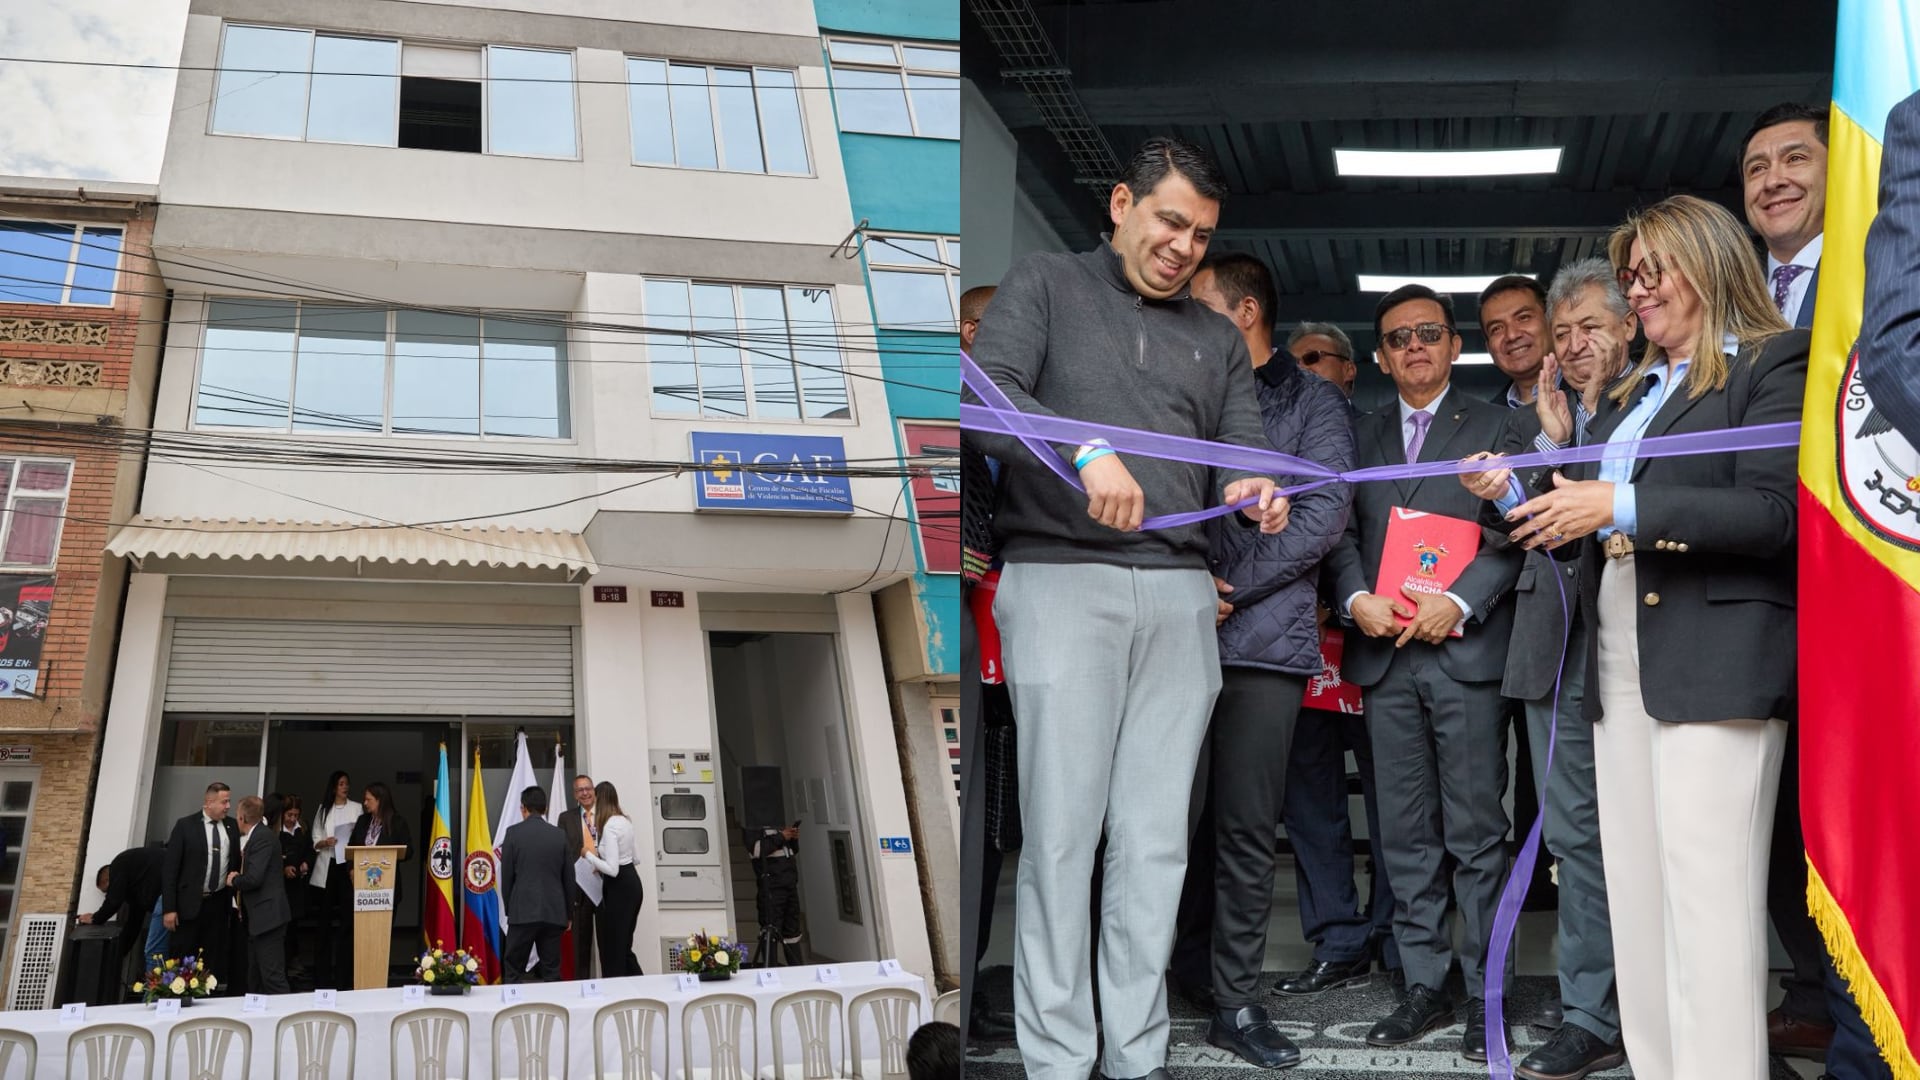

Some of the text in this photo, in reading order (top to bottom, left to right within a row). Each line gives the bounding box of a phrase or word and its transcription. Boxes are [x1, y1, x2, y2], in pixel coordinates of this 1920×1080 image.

[753, 452, 832, 484] CAF
[1404, 581, 1442, 595] SOACHA
[357, 898, 390, 906] SOACHA
